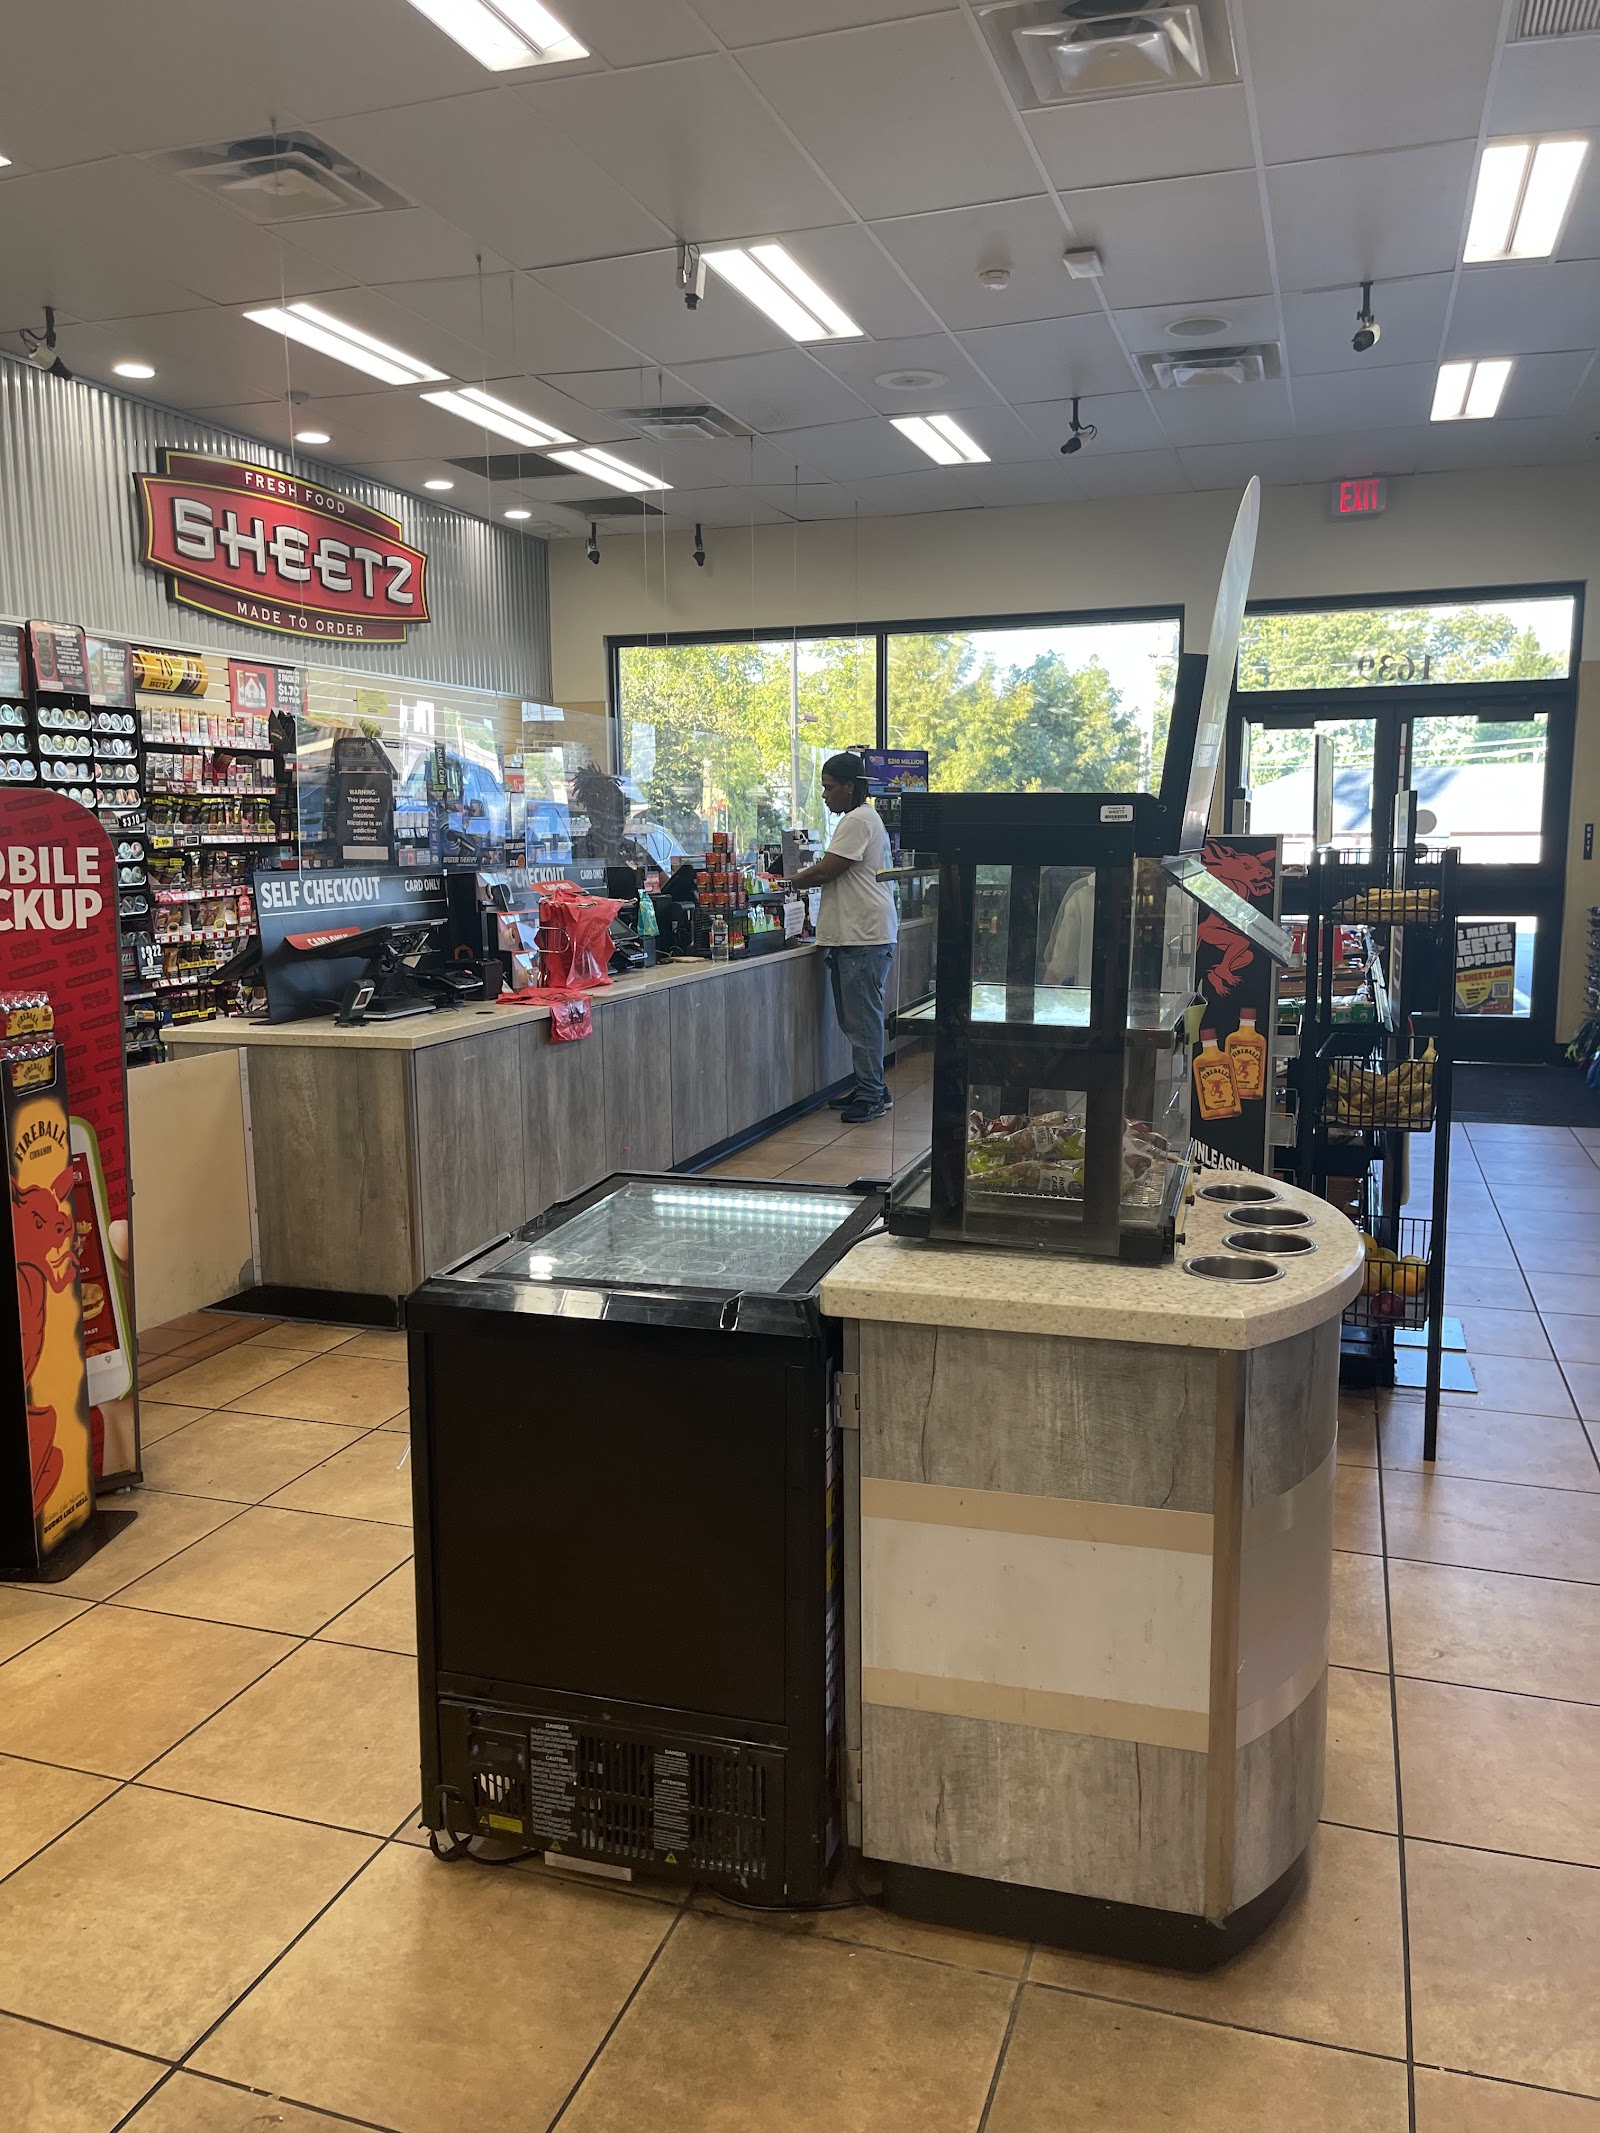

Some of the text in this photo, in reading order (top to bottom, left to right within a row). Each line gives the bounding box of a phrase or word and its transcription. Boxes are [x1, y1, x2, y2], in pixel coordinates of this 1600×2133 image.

[244, 471, 346, 515] FRESH FOOD
[1339, 479, 1381, 513] EXIT
[173, 497, 415, 606] SHEETZ
[236, 601, 364, 637] MADE TO ORDER
[900, 758, 925, 766] MILLION
[348, 788, 378, 796] WARNING:
[346, 796, 381, 805] This product
[0, 846, 101, 885] BILE
[260, 877, 381, 909] SELF CHECKOUT
[404, 877, 442, 893] CARD ONLY
[1465, 923, 1509, 939] MAKE
[1231, 1048, 1261, 1061] FIREBALL
[1201, 1067, 1231, 1080] FIREBALL
[14, 1120, 66, 1164] FIREBALL
[545, 1722, 570, 1731] DANGER
[545, 1755, 569, 1764] CAUTION
[664, 1748, 687, 1758] DANGER
